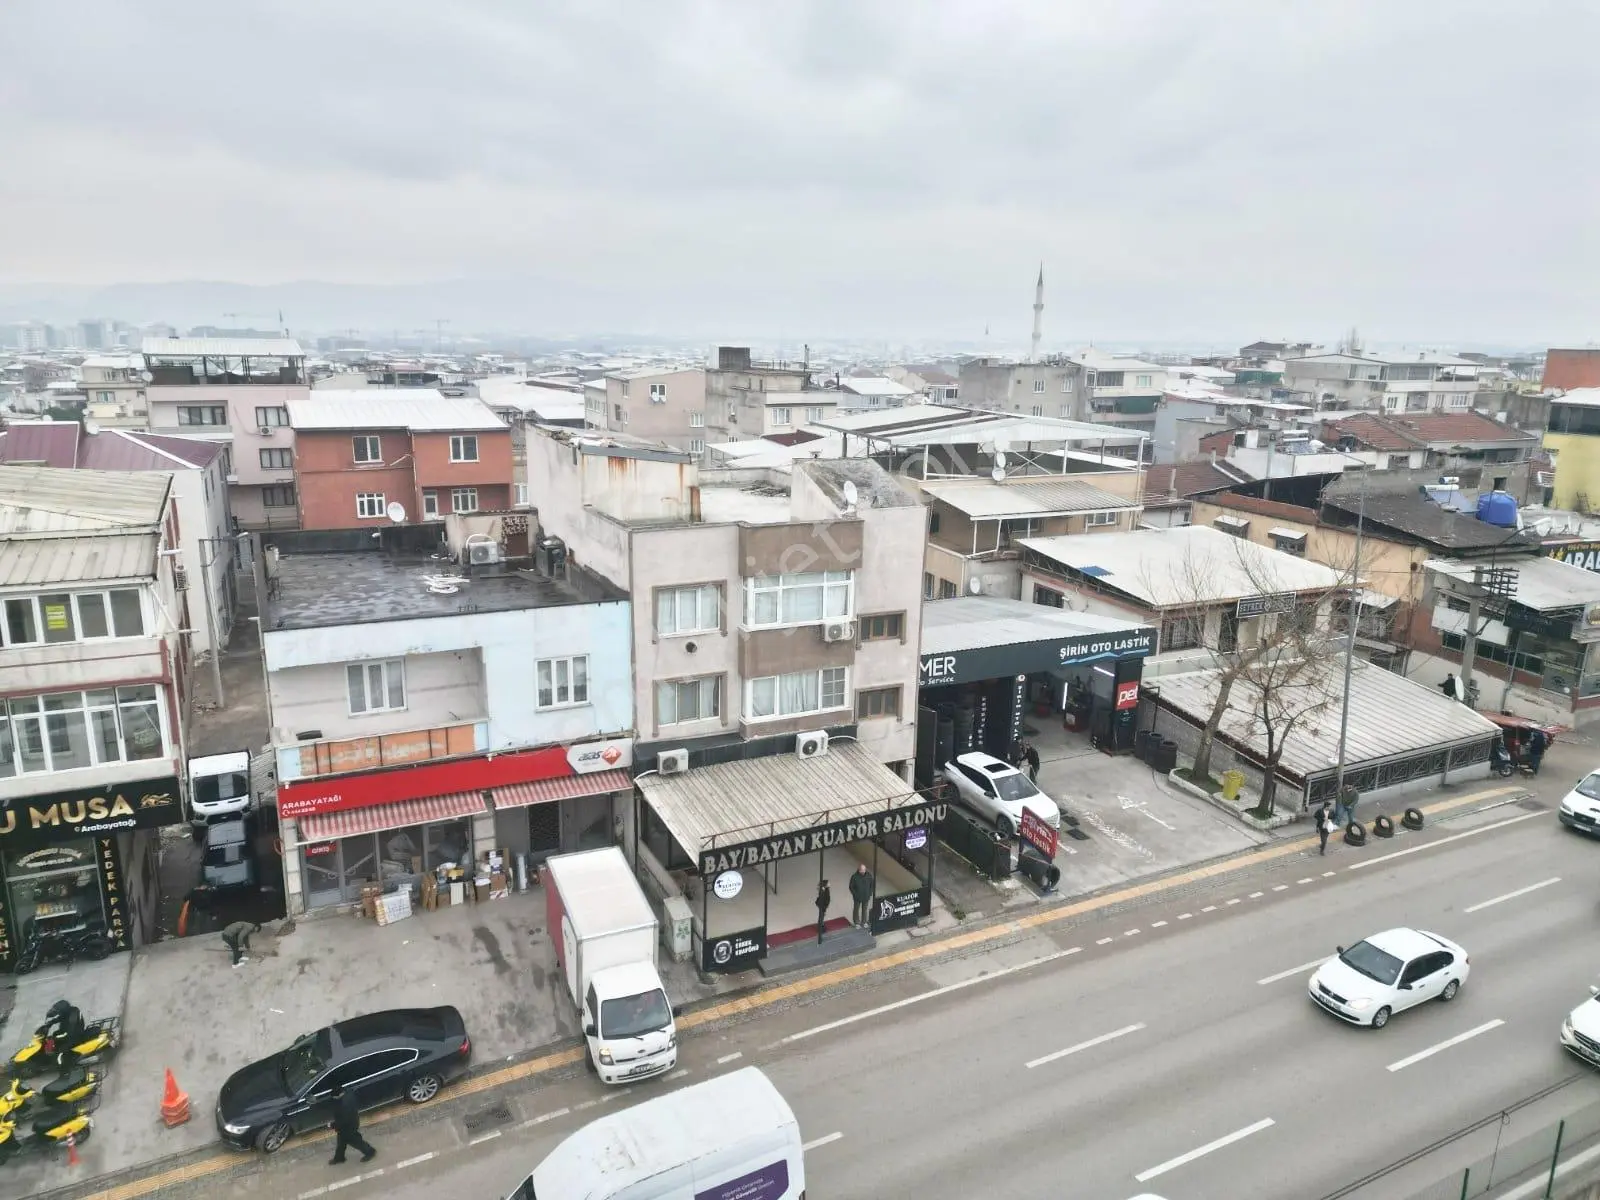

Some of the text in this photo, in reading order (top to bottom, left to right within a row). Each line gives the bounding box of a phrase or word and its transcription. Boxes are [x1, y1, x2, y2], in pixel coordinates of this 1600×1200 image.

[1060, 635, 1149, 659] ŞİRİN OTO LASTİK
[29, 794, 134, 829] MUSA
[282, 794, 341, 810] ARABAYATAĞI
[81, 818, 137, 833] Arabayatağı
[704, 803, 948, 874] BAY/BAYAN KUAFÖR SALONU
[101, 838, 125, 948] YEDEK PARÇA
